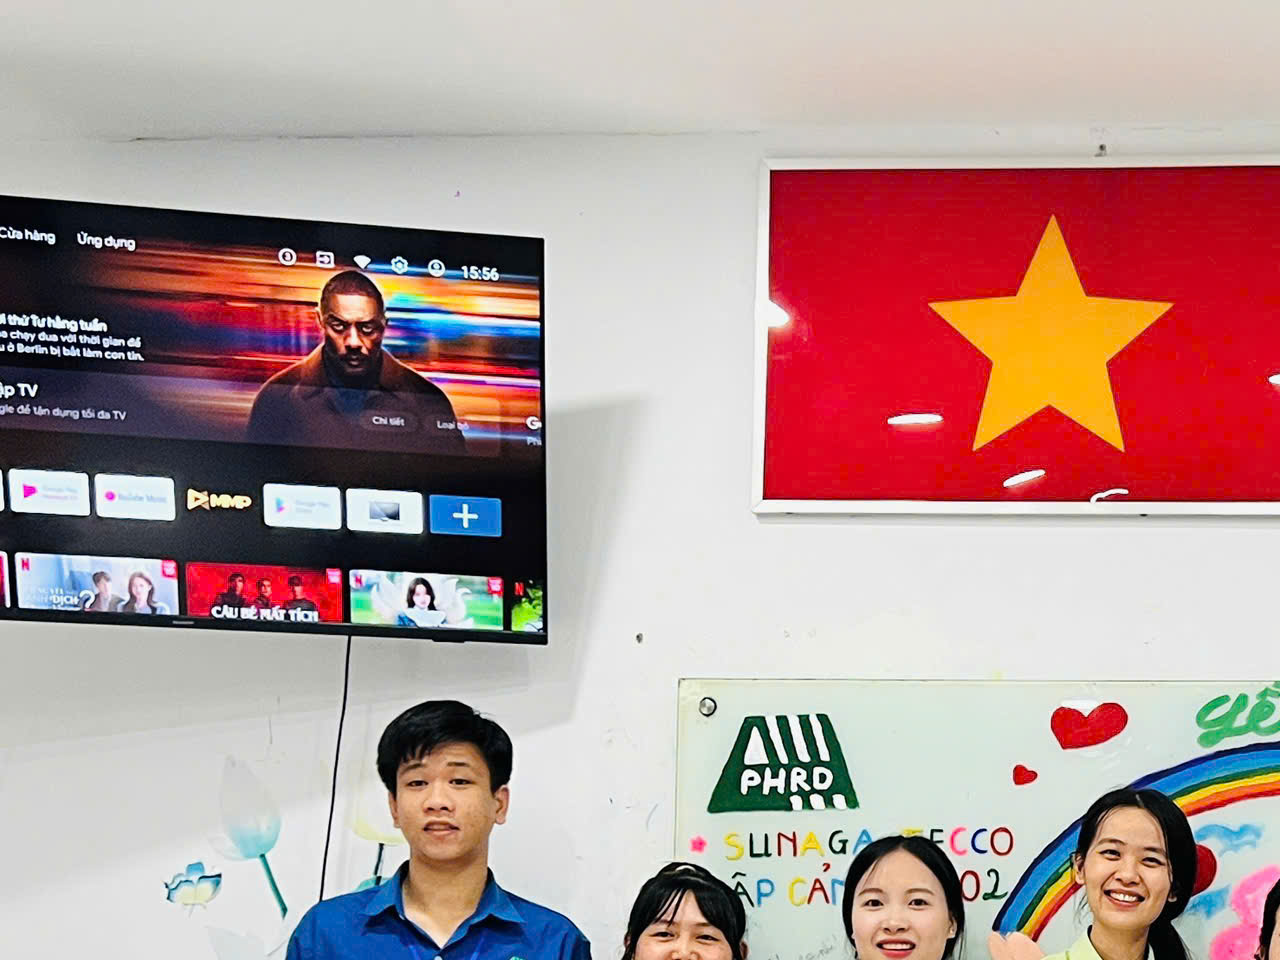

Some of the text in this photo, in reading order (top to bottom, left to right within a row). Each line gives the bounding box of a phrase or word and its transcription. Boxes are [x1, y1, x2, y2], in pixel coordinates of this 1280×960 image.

[24, 229, 56, 245] hàng
[104, 235, 136, 251] dụng
[461, 265, 500, 281] 15:56
[102, 336, 125, 348] gian
[16, 342, 48, 354] Berlin
[104, 350, 125, 360] con
[17, 382, 38, 398] TV
[112, 410, 126, 420] TV
[740, 766, 834, 796] PHRD
